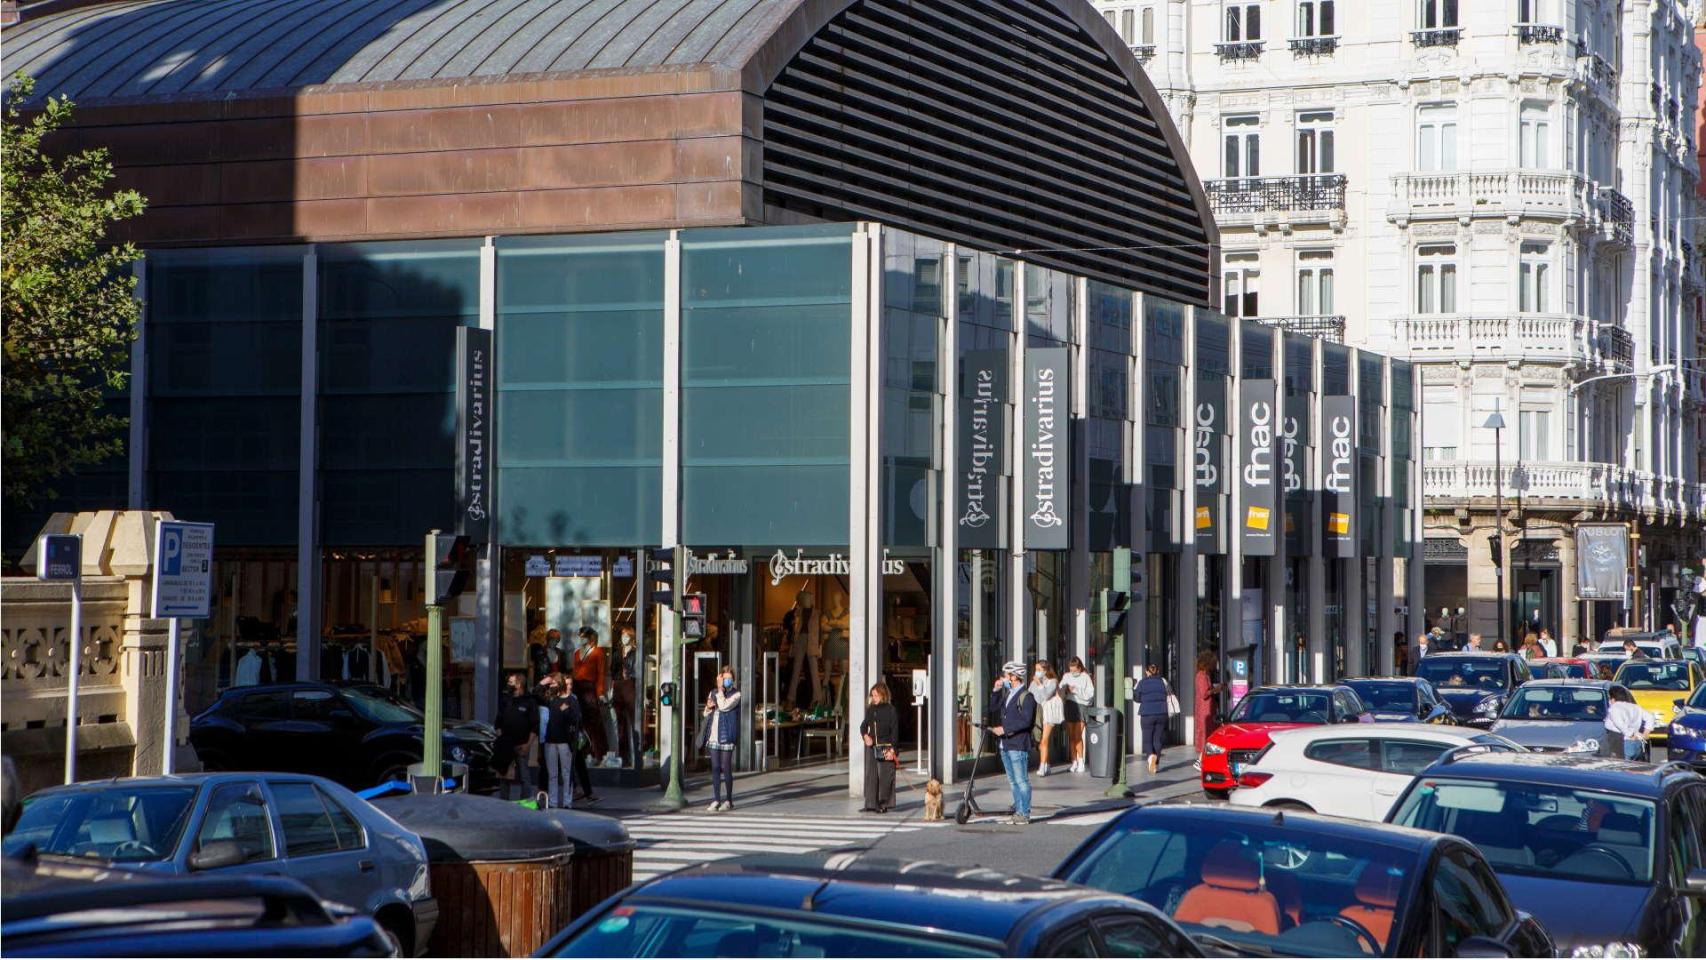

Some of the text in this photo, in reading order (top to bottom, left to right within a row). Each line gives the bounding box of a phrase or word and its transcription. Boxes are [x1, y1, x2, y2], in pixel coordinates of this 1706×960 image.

[468, 349, 484, 521] stradivarius
[1030, 368, 1062, 528] stradivarius
[1244, 401, 1270, 487] fnac
[1326, 416, 1350, 494] fnac
[165, 532, 180, 571] P
[769, 548, 905, 587] stradivus
